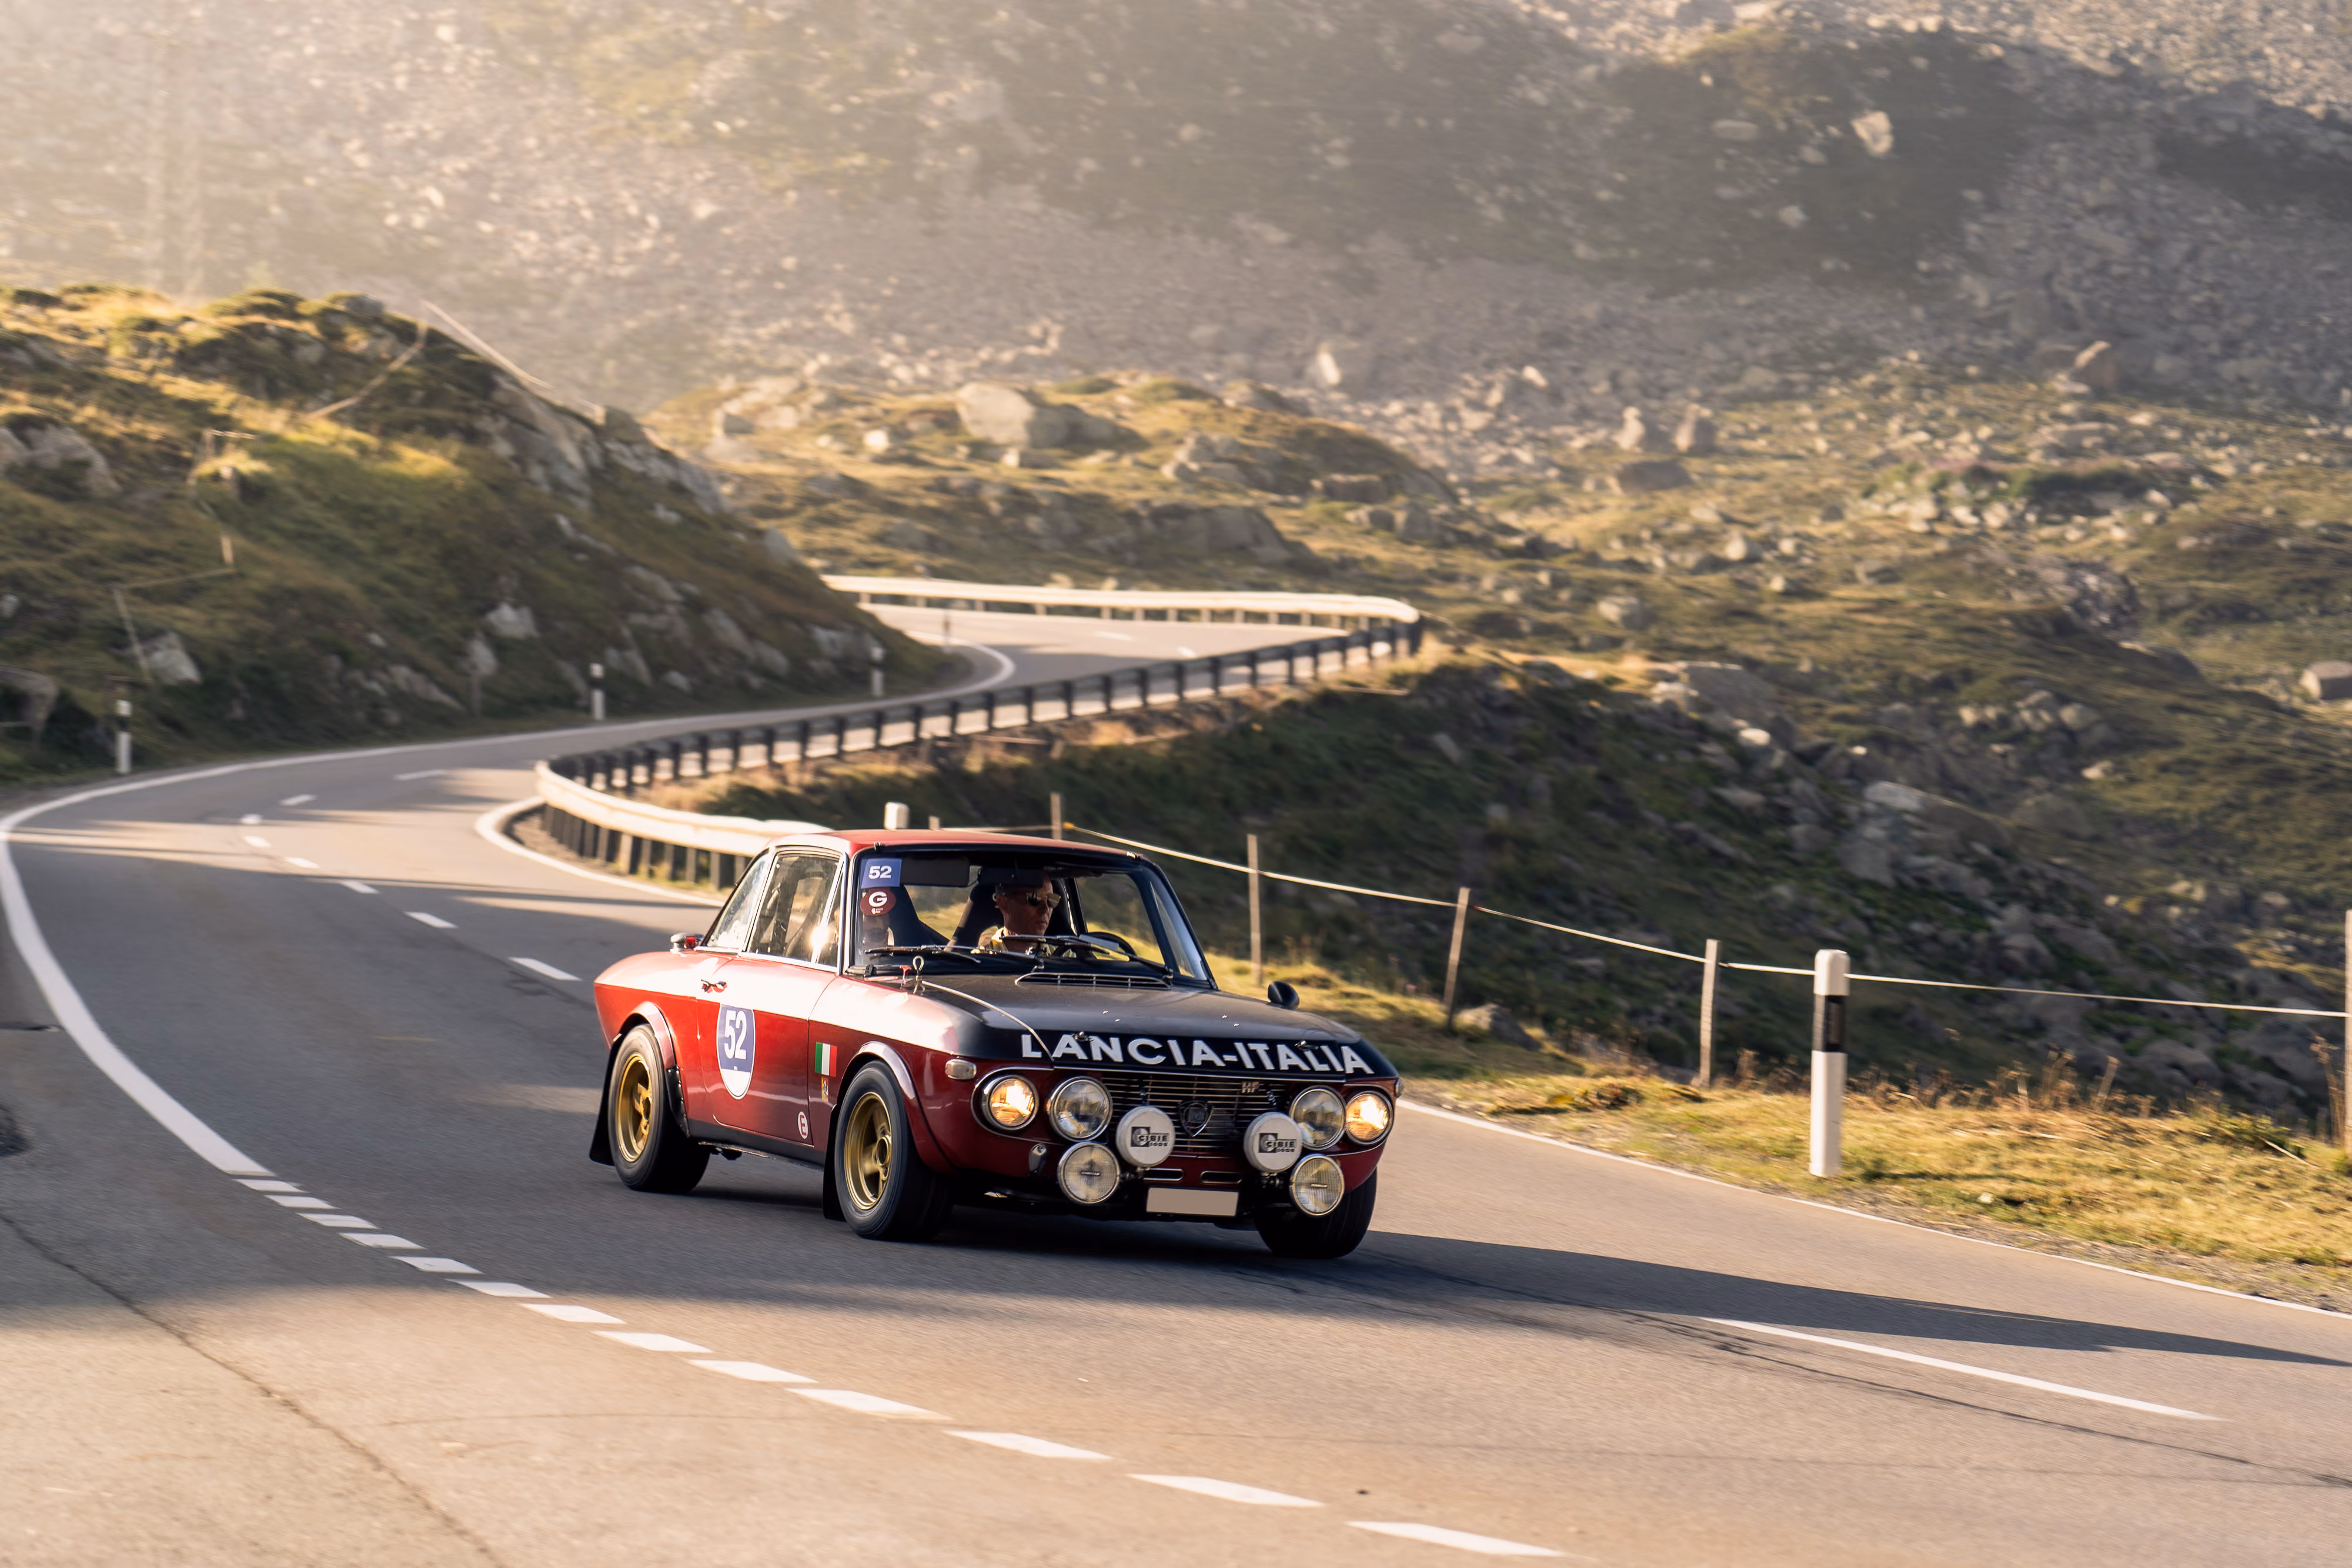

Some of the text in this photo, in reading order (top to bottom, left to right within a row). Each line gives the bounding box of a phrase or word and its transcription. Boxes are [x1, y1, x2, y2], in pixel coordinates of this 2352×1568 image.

[868, 865, 892, 879] 52
[868, 891, 887, 907] G
[724, 1010, 747, 1059] 52
[1021, 1034, 1375, 1074] LANCIA-ITALIA
[800, 1115, 807, 1136] E
